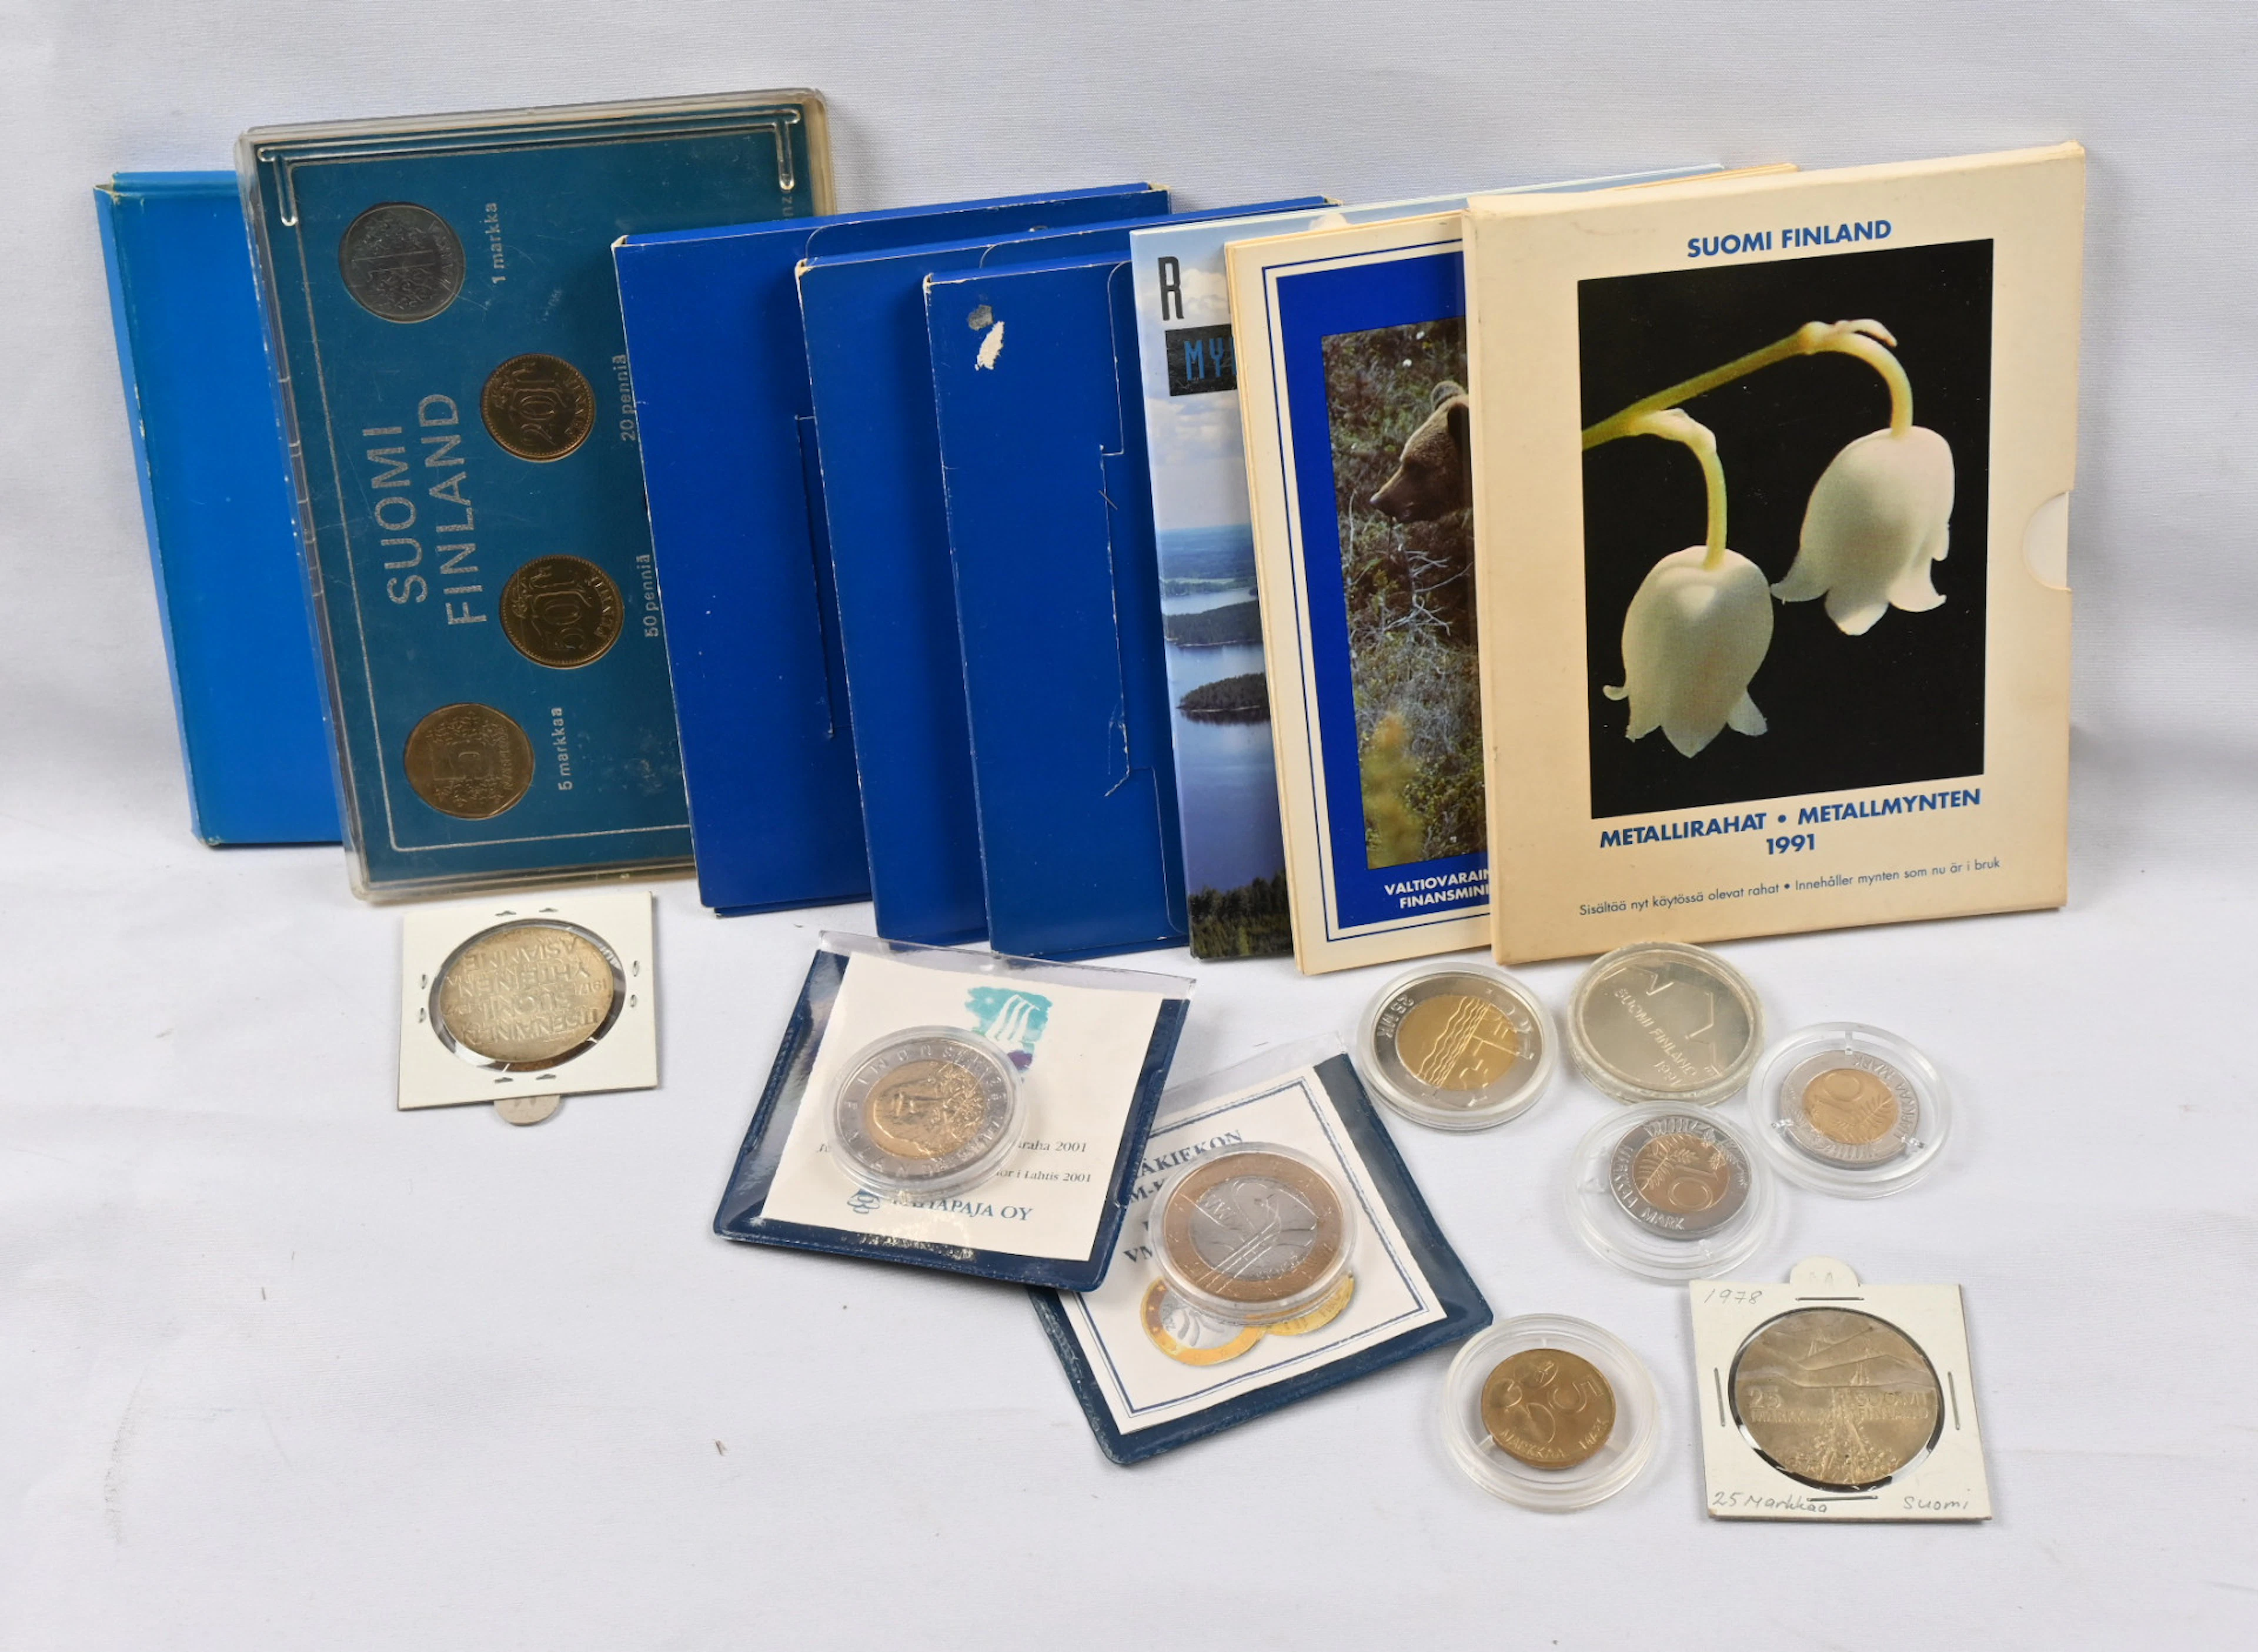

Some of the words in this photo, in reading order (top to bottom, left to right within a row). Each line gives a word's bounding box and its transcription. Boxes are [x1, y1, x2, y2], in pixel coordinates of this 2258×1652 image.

[483, 203, 505, 269] markka
[1688, 231, 1772, 258] SUOMI
[1782, 219, 1892, 249] FINLAND
[619, 419, 636, 442] 20
[362, 426, 429, 604] SUOMI
[417, 393, 487, 626] FINLAND
[643, 618, 659, 637] 50
[551, 707, 572, 776] markkaa
[558, 781, 573, 791] 5
[1600, 812, 1766, 848] METALLIRAHAT
[1798, 788, 1981, 825] METALLMYNTEN
[1766, 834, 1815, 855] 1991
[1579, 901, 1626, 916] Sisältää
[1631, 900, 1649, 911] nyt
[1653, 892, 1703, 909] käytössä
[1708, 888, 1744, 901] olevat
[1748, 882, 1779, 897] rahat
[1795, 875, 1853, 891] Innehåller
[1858, 871, 1899, 887] mynten
[1904, 868, 1927, 878] som
[1932, 866, 1946, 875] nu
[1949, 862, 1963, 874] är
[1966, 861, 1970, 871] i
[1975, 856, 2000, 871] bruk
[1649, 1028, 1698, 1076] FINLAND
[1055, 1141, 1087, 1152] 2001
[1142, 1129, 1243, 1176] ÄKIEKON
[1025, 1171, 1059, 1181] Lahtis
[1063, 1172, 1091, 1182] 2001
[1001, 1205, 1034, 1221] OY
[1704, 1288, 1762, 1304] 1978
[1712, 1491, 1743, 1507] 25
[1903, 1493, 1969, 1510] Suomi
